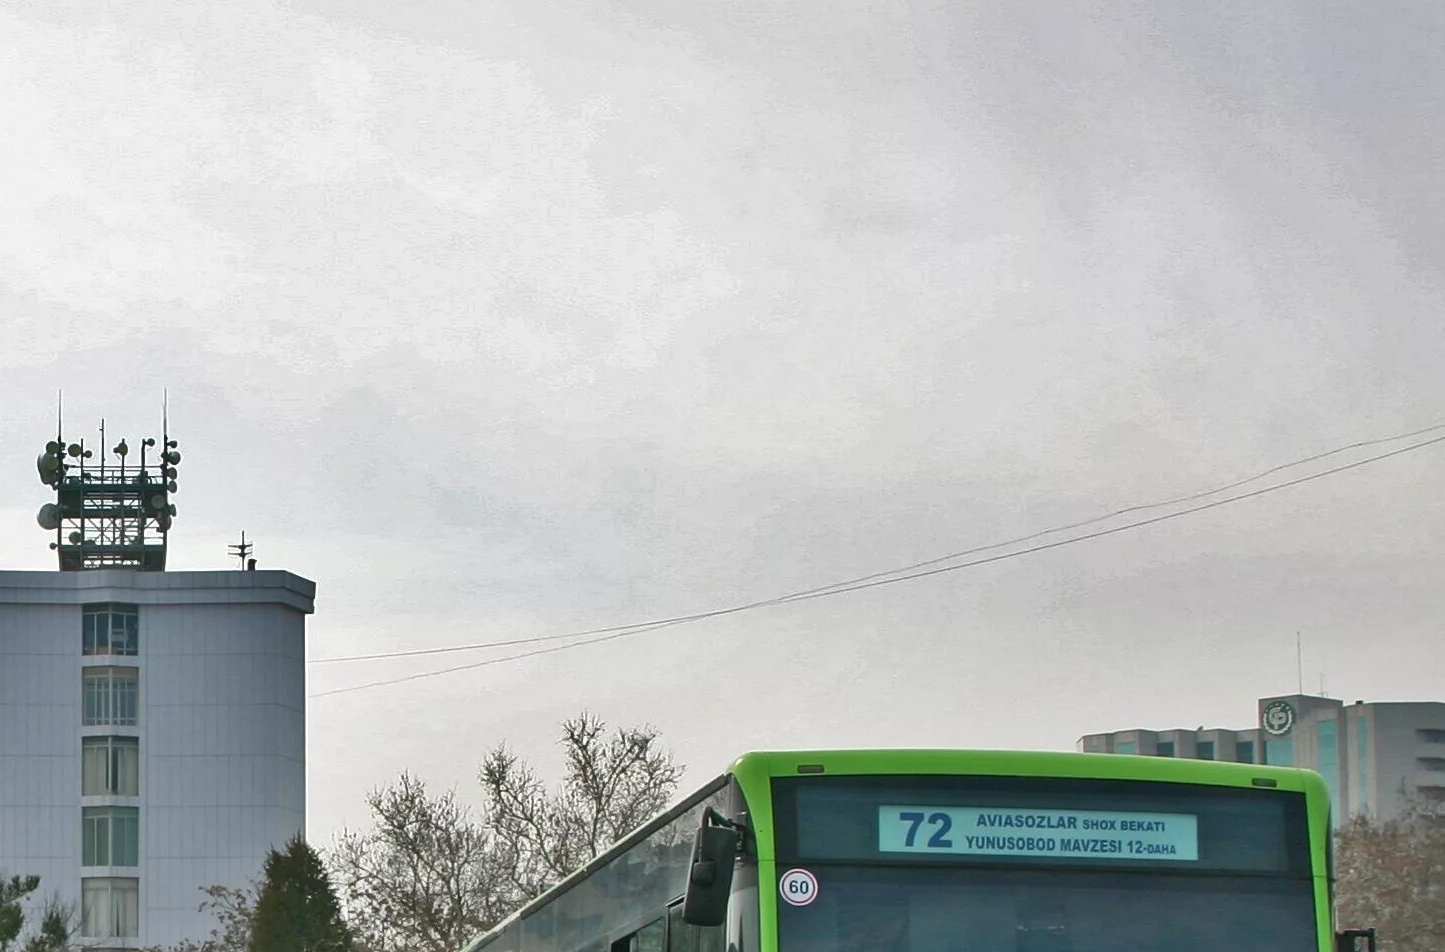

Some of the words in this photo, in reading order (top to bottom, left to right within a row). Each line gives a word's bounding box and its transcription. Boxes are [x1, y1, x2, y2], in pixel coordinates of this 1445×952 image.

[899, 811, 953, 849] 72
[976, 813, 1078, 830] AVIASOZLAR
[1082, 819, 1117, 832] SHOX
[1120, 820, 1166, 832] BEKATI
[965, 835, 1056, 852] YUNUSOBOD
[1060, 838, 1122, 853] MAVZESI
[1126, 840, 1177, 855] 12-DAHA
[789, 880, 809, 895] 60
